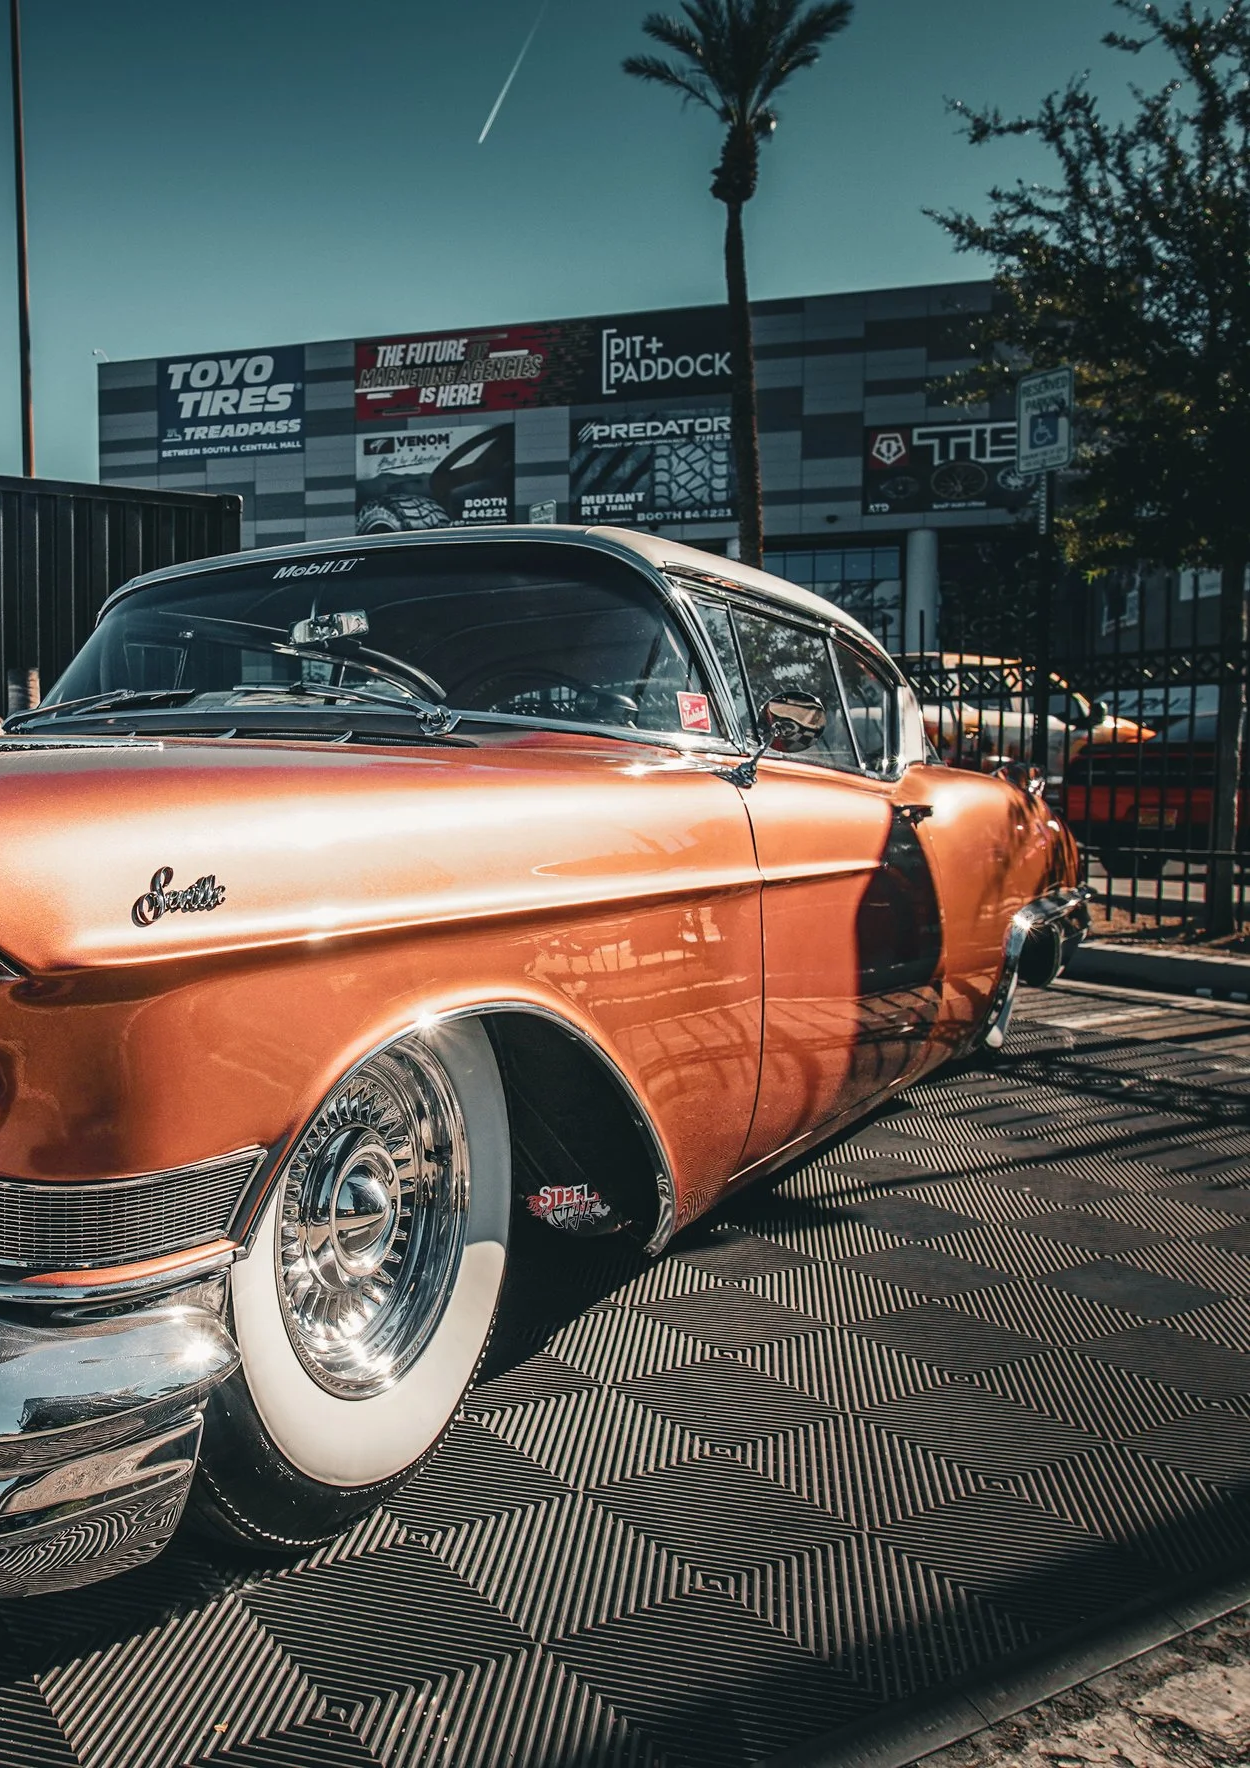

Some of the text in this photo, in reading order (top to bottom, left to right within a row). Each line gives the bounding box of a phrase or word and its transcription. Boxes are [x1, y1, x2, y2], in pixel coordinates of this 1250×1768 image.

[376, 344, 407, 368] THE
[406, 338, 469, 365] FUTURE
[167, 355, 275, 390] TOYO
[359, 354, 543, 389] MARKETING AGENCIES
[610, 352, 732, 384] PADDOCK
[178, 383, 295, 418] TIRES
[418, 383, 484, 408] IS HERE!
[184, 418, 302, 440] TREADPASS
[593, 416, 732, 441] PREDATOR
[694, 433, 732, 442] TIRES
[162, 440, 302, 458] BETWEEN SOUTH & CENTRAL HALL
[396, 433, 450, 447] VENOM
[464, 497, 508, 508] BOOTH
[581, 492, 646, 505] MUTANT
[581, 503, 633, 516] RT TRAIL
[637, 511, 682, 522] BOOTH
[272, 561, 335, 580] Mobil
[539, 1184, 596, 1209] STEEL
